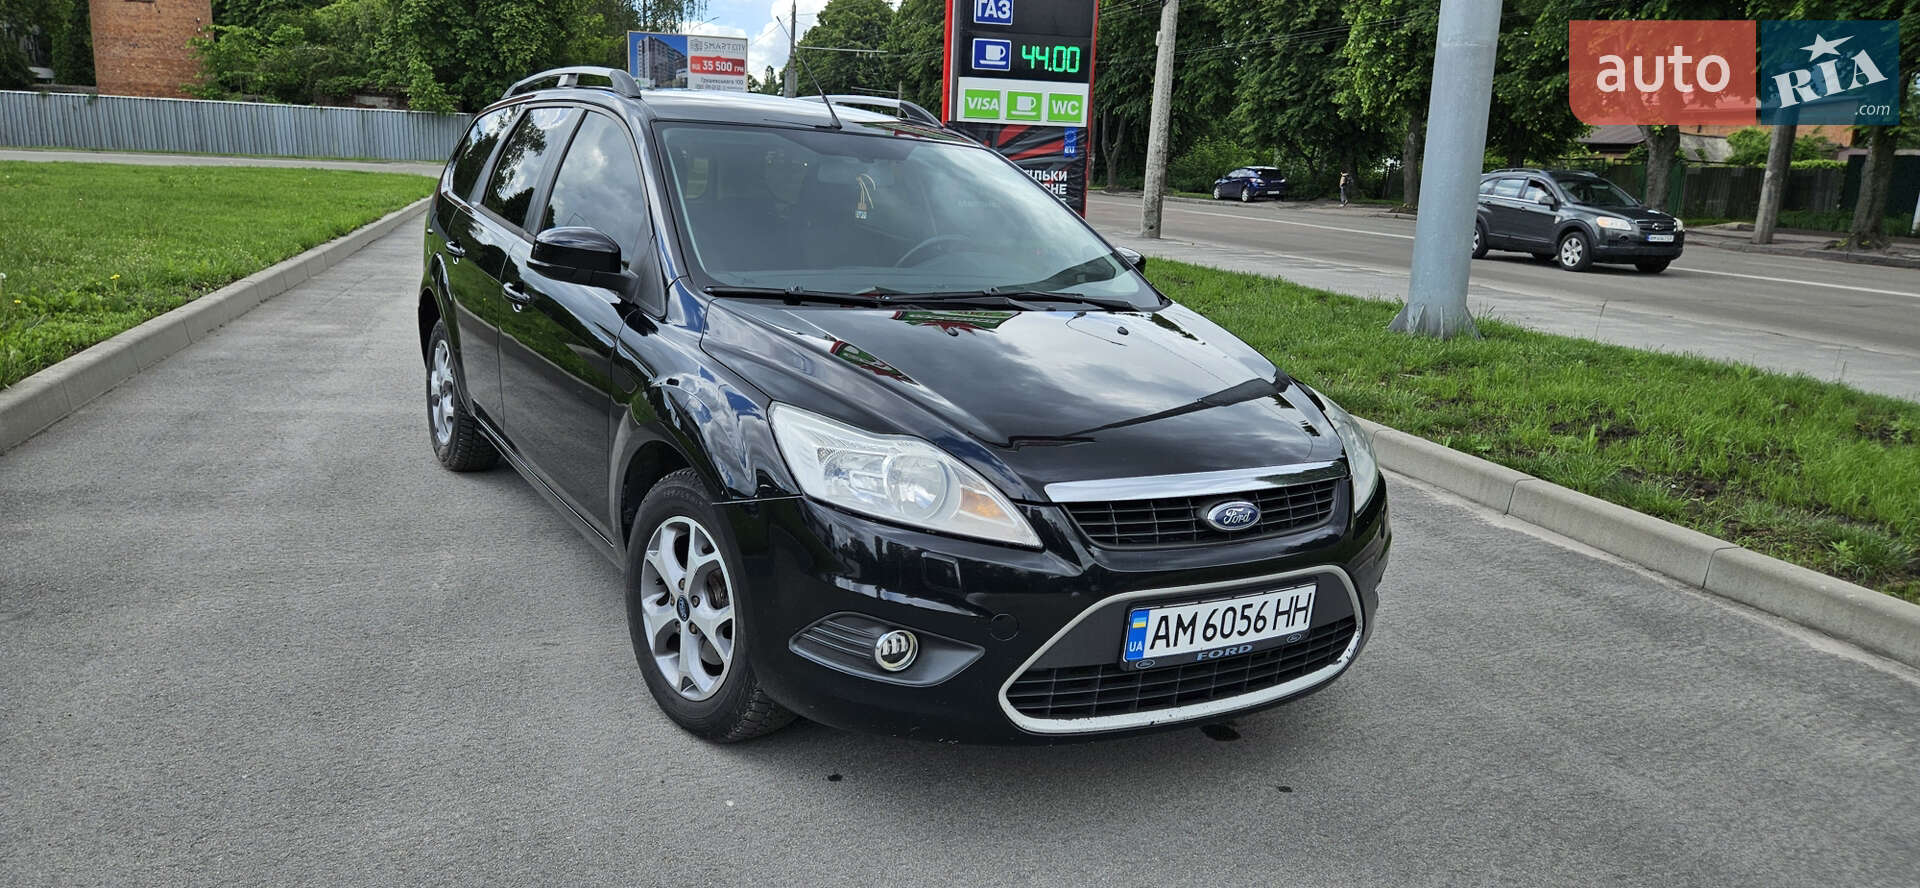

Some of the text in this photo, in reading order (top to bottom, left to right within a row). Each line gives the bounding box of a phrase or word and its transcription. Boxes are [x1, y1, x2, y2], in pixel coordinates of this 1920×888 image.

[977, 0, 1011, 19] ГАЗ
[702, 60, 713, 70] 35
[715, 61, 732, 72] 500
[1021, 45, 1081, 73] 44.00
[966, 97, 1000, 111] VISA
[1051, 101, 1080, 116] WC
[1064, 146, 1075, 154] EU
[1223, 508, 1251, 525] Ford
[1149, 592, 1313, 650] AM 6056 HH
[1129, 641, 1144, 652] UA
[1196, 644, 1253, 661] FORD
